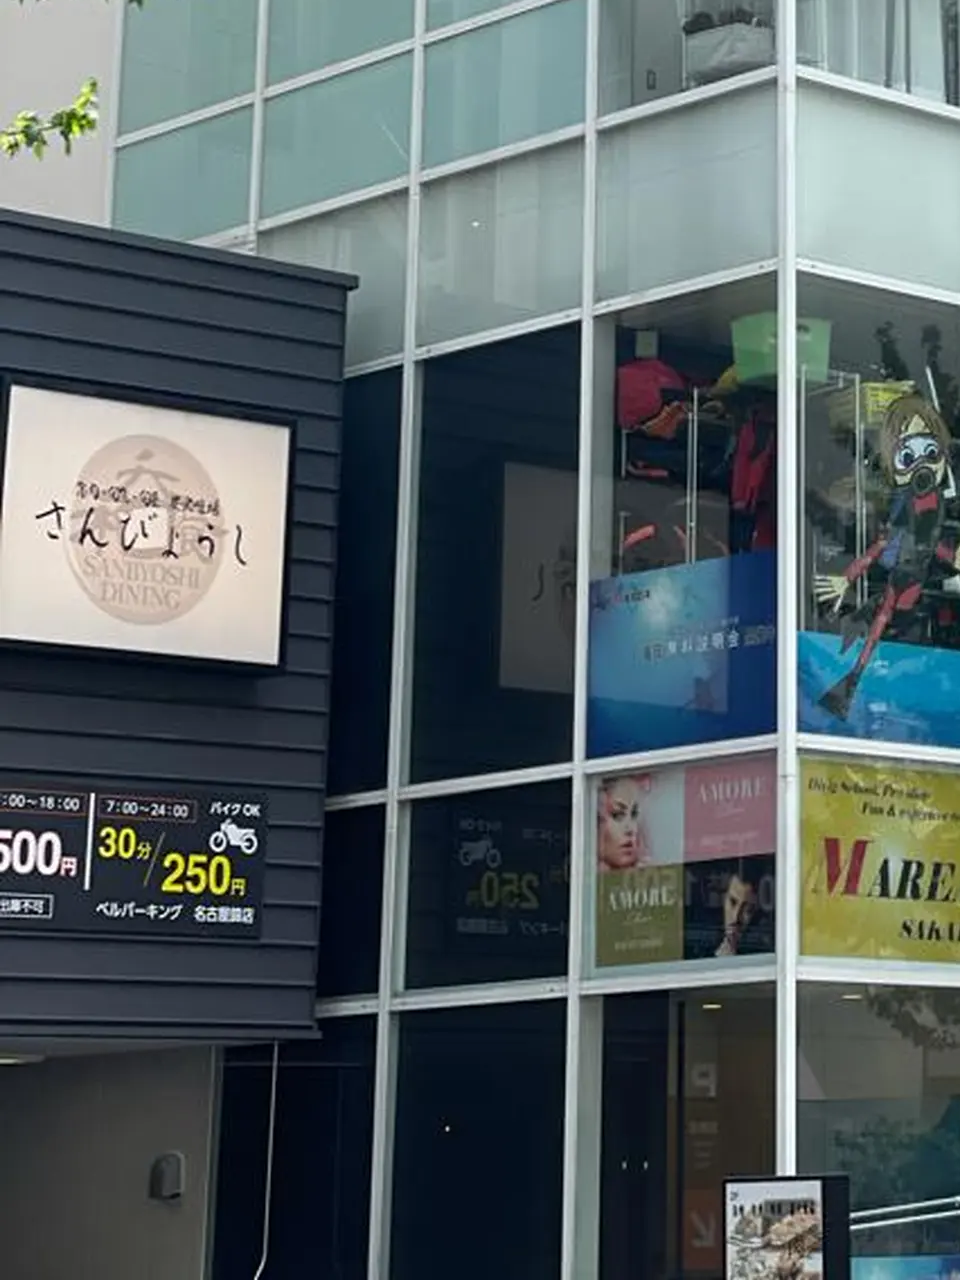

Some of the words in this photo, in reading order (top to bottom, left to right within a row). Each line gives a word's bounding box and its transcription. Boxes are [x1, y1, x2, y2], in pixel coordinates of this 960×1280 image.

[36, 501, 248, 566] さんびょうし
[100, 581, 181, 610] DINING
[161, 852, 246, 897] 250円
[608, 886, 673, 911] AMORE
